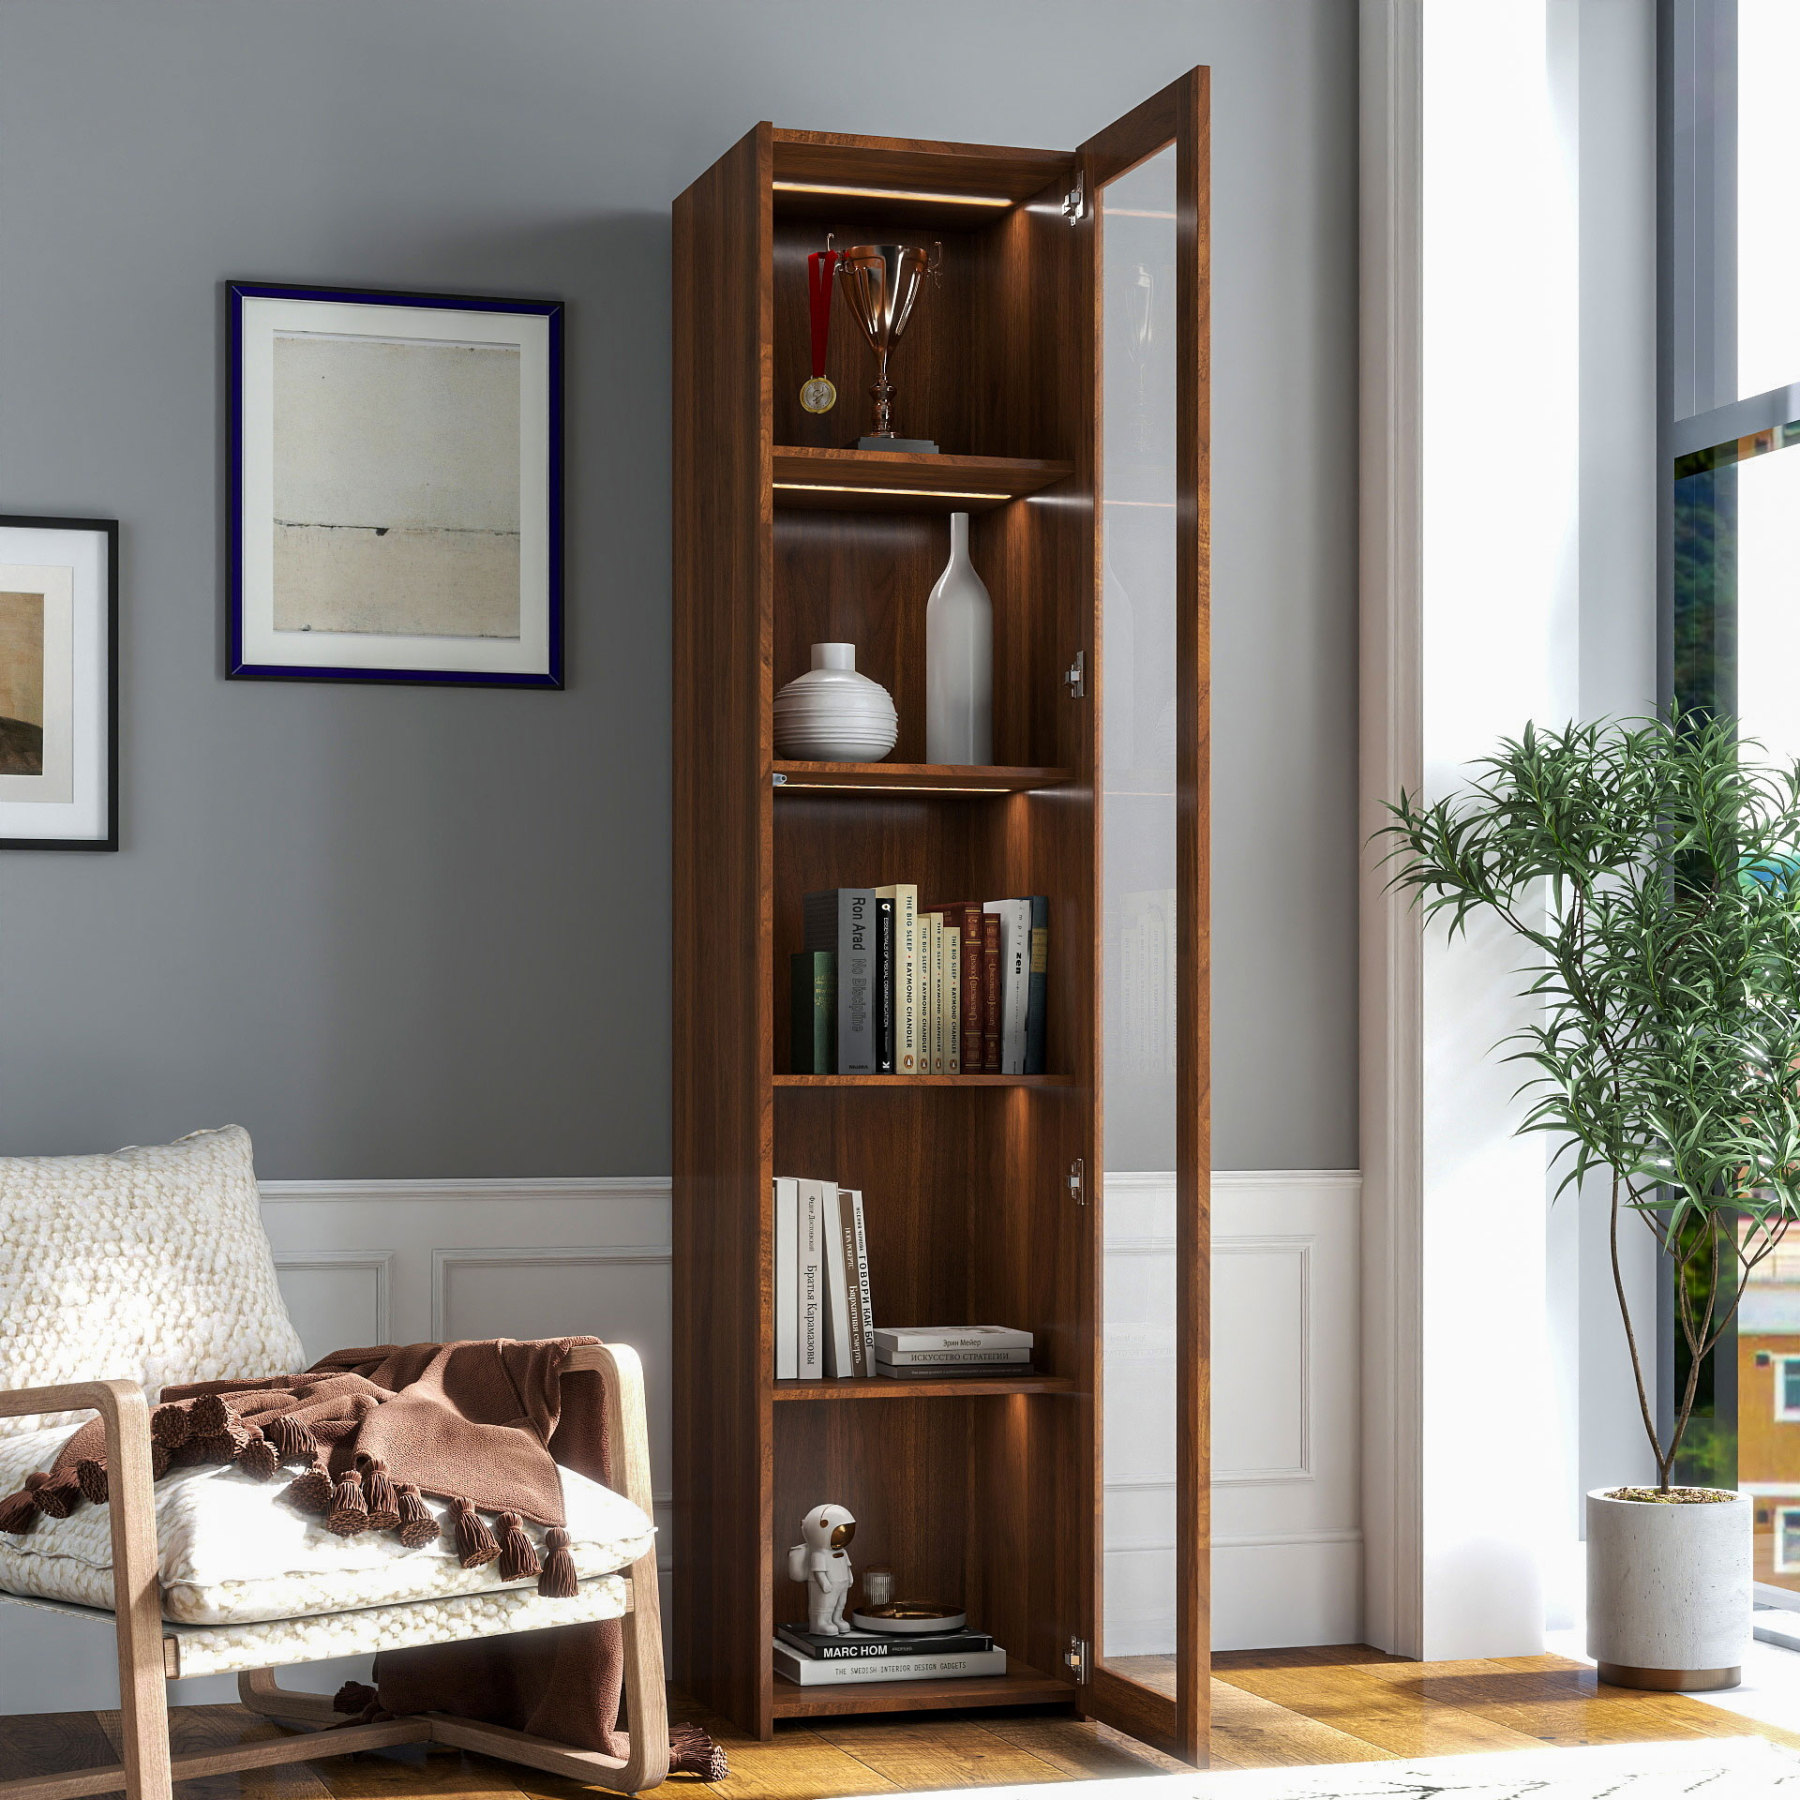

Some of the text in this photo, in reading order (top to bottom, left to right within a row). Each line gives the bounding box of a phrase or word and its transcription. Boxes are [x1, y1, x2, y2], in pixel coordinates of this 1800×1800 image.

[849, 898, 866, 1032] Ron Arad No Discipline
[804, 1265, 817, 1365] Братья Карамазовы
[848, 1285, 862, 1363] Бархатная смерть
[859, 1256, 869, 1304] ГОВОРИ
[865, 1331, 874, 1349] БОГ
[960, 1338, 981, 1346] Мейер
[824, 1646, 858, 1658] MARC
[861, 1645, 887, 1656] HOM
[850, 1666, 877, 1674] SWEDISH
[881, 1665, 910, 1673] INTERIOR
[914, 1663, 937, 1671] DESIGN
[940, 1661, 966, 1670] GADGETS
